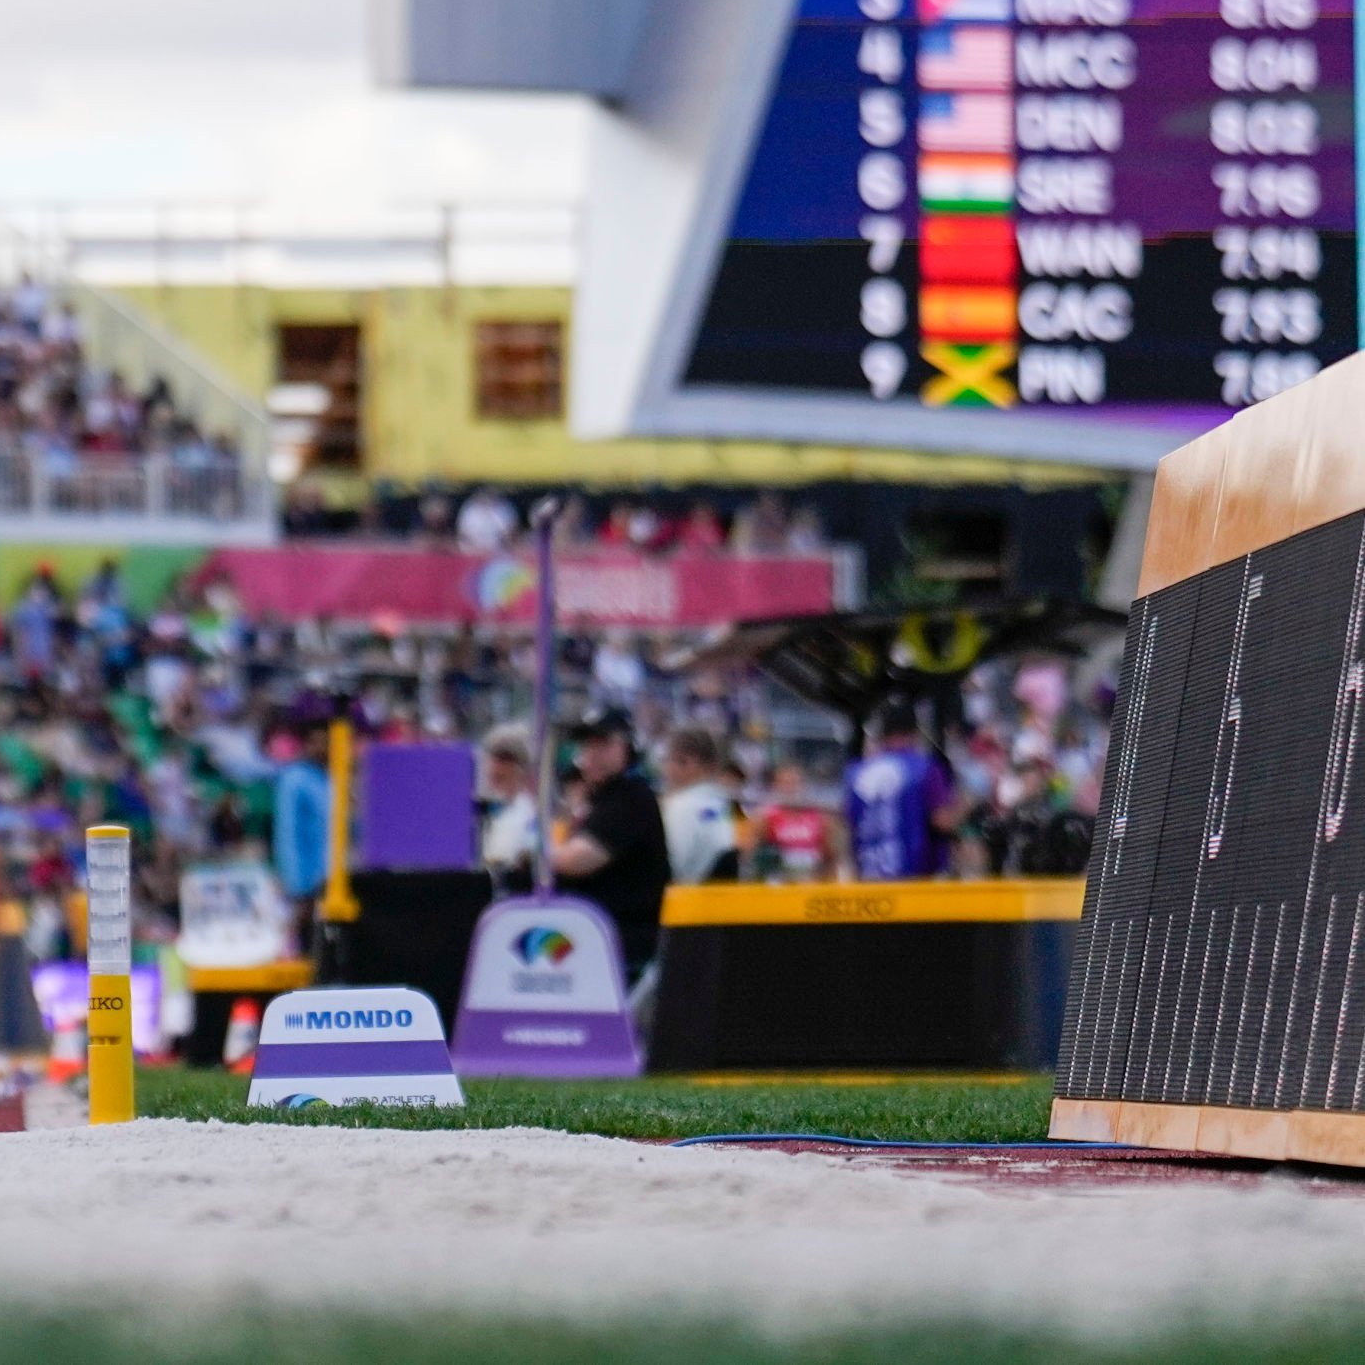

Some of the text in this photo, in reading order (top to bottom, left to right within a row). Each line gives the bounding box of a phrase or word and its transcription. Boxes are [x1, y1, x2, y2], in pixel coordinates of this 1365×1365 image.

[857, 27, 904, 84] 4
[1016, 31, 1137, 90] MCC
[858, 88, 905, 148] 5
[1016, 93, 1123, 153] DEN
[857, 151, 906, 211] 6
[859, 213, 904, 273] 7
[1016, 220, 1143, 278] WAN
[859, 277, 907, 338] 8
[859, 340, 907, 400] 9
[1018, 345, 1106, 404] PIN
[803, 897, 894, 919] SEIKO
[307, 1009, 413, 1030] MONDO
